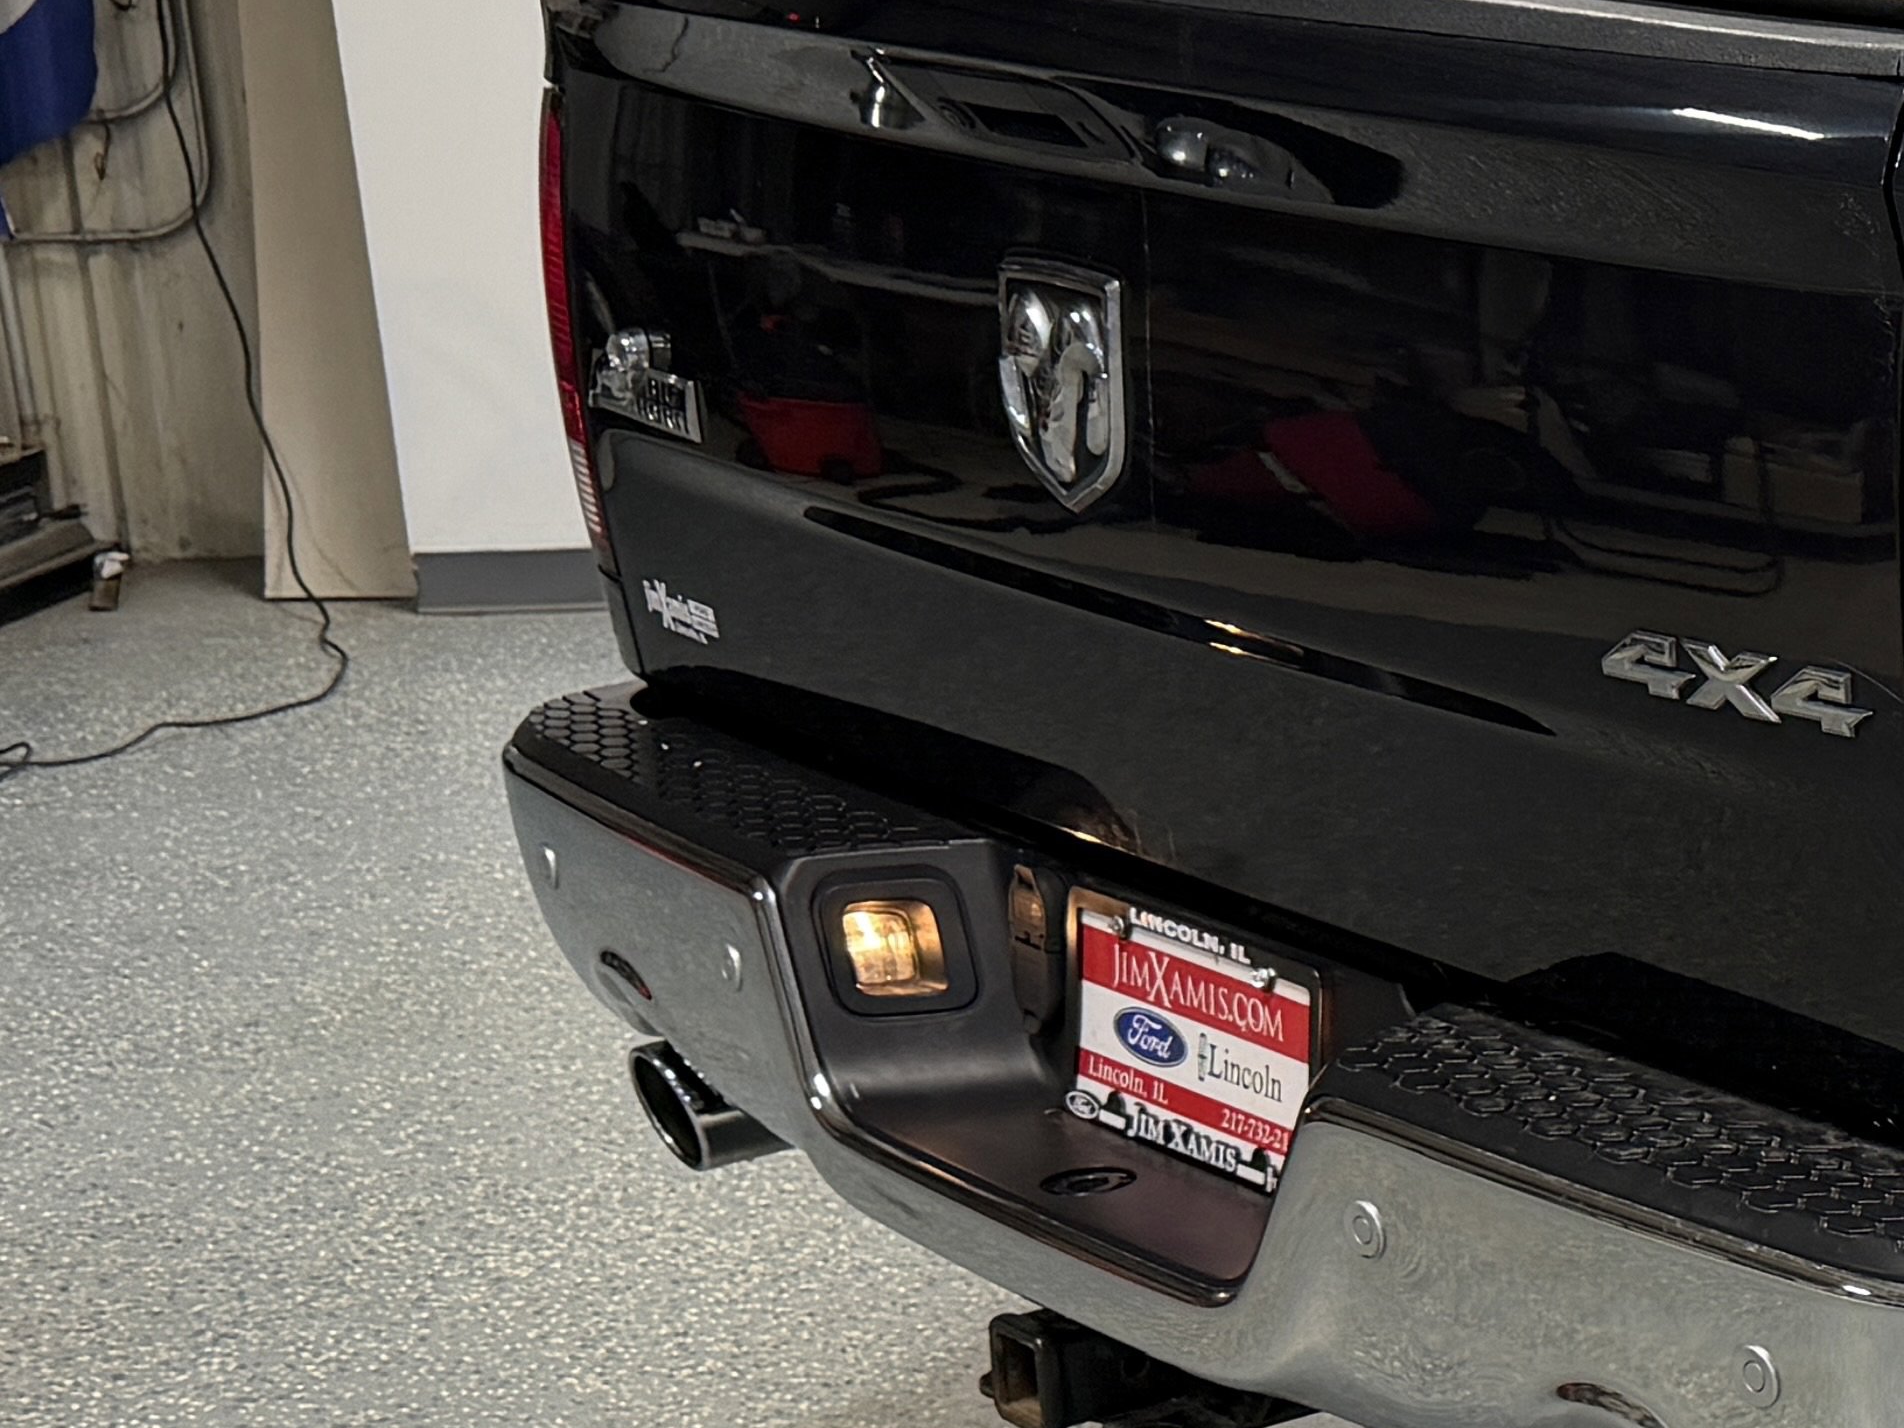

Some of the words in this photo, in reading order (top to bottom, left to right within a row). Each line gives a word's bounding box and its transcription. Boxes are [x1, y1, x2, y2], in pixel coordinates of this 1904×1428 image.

[1601, 628, 1875, 738] 4X4
[1129, 907, 1225, 954] LINCOLN,
[1230, 942, 1250, 964] IL
[1126, 1014, 1175, 1060] Ford
[1088, 1057, 1147, 1098] Lincoln,
[1152, 1080, 1169, 1105] IL
[1208, 1044, 1283, 1103] Lincoln
[1126, 1111, 1166, 1145] JIM
[1167, 1125, 1238, 1173] XAMIS
[1221, 1108, 1290, 1154] 217-732-21
